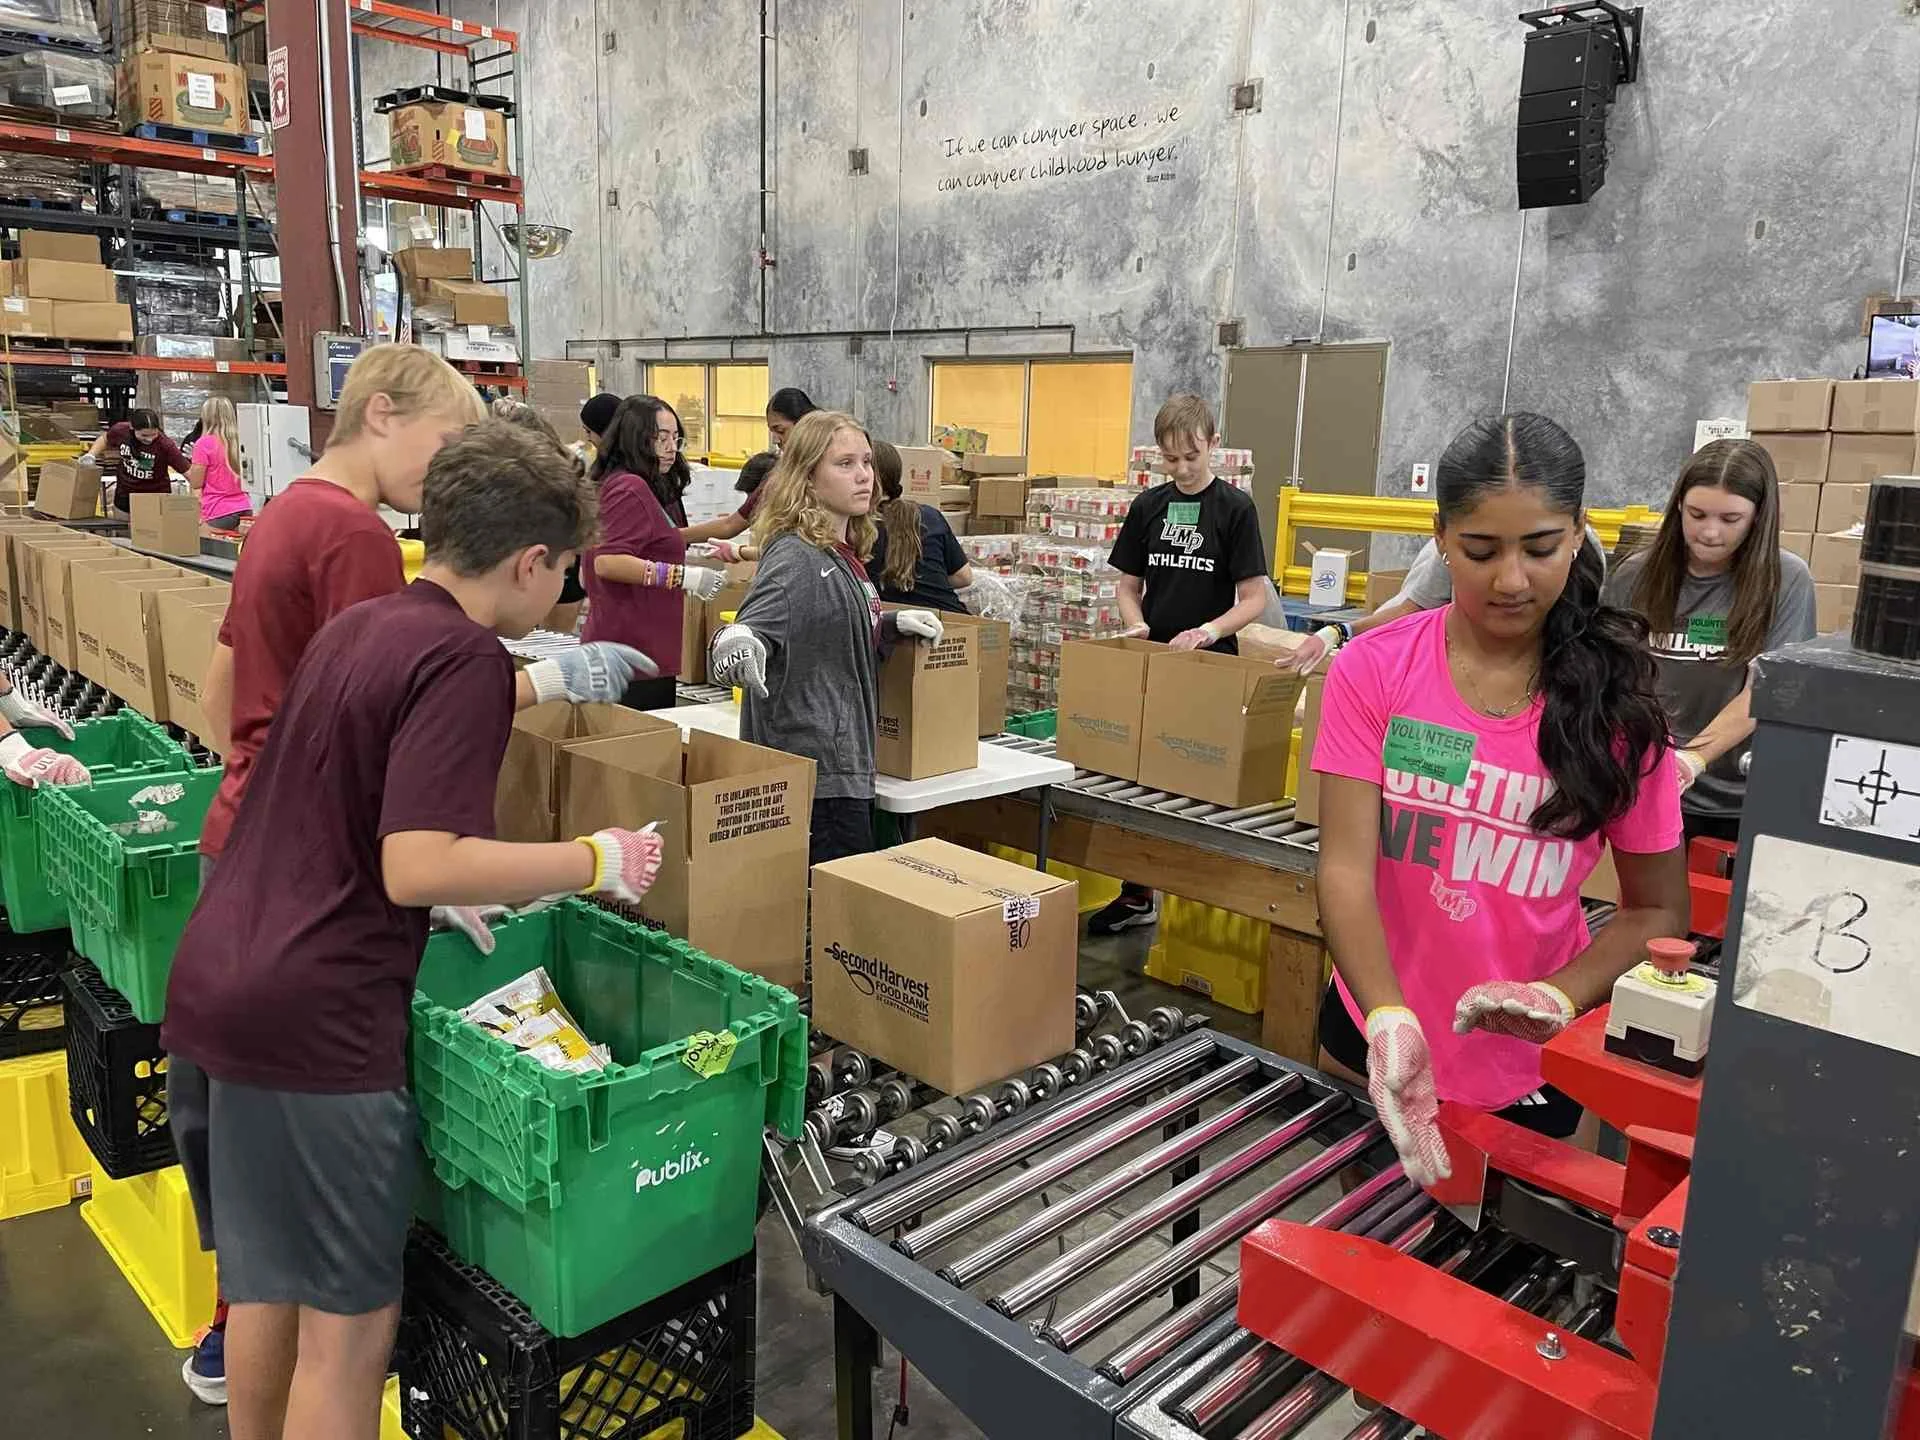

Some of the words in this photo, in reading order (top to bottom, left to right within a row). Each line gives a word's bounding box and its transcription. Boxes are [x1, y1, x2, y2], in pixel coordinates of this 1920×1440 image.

[968, 138, 985, 153] we
[991, 134, 1017, 150] can
[1023, 121, 1087, 146] conquer
[1157, 106, 1180, 123] we
[938, 177, 962, 191] can
[967, 166, 1026, 190] conquer
[1031, 149, 1107, 178] childhood
[1148, 553, 1215, 572] ATHLETICS
[715, 649, 751, 675] ULINE
[1390, 720, 1473, 753] VOLUNTEER
[715, 793, 721, 804] IT
[722, 792, 729, 803] IS
[730, 786, 761, 801] UNLAWFUL
[762, 784, 770, 794] TO
[770, 781, 788, 793] OFFER
[717, 814, 742, 829] PORTION
[743, 811, 751, 822] OF
[759, 808, 771, 819] FOR
[771, 805, 785, 817] SALE
[720, 803, 734, 816] THIS
[709, 829, 730, 843] UNDER
[731, 826, 743, 838] ANY
[1450, 822, 1575, 898] WIN
[832, 942, 877, 978] Second
[879, 960, 930, 1001] Harvest
[875, 980, 901, 1000] FOOD
[903, 993, 929, 1014] BANK
[635, 1150, 703, 1194] Publix
